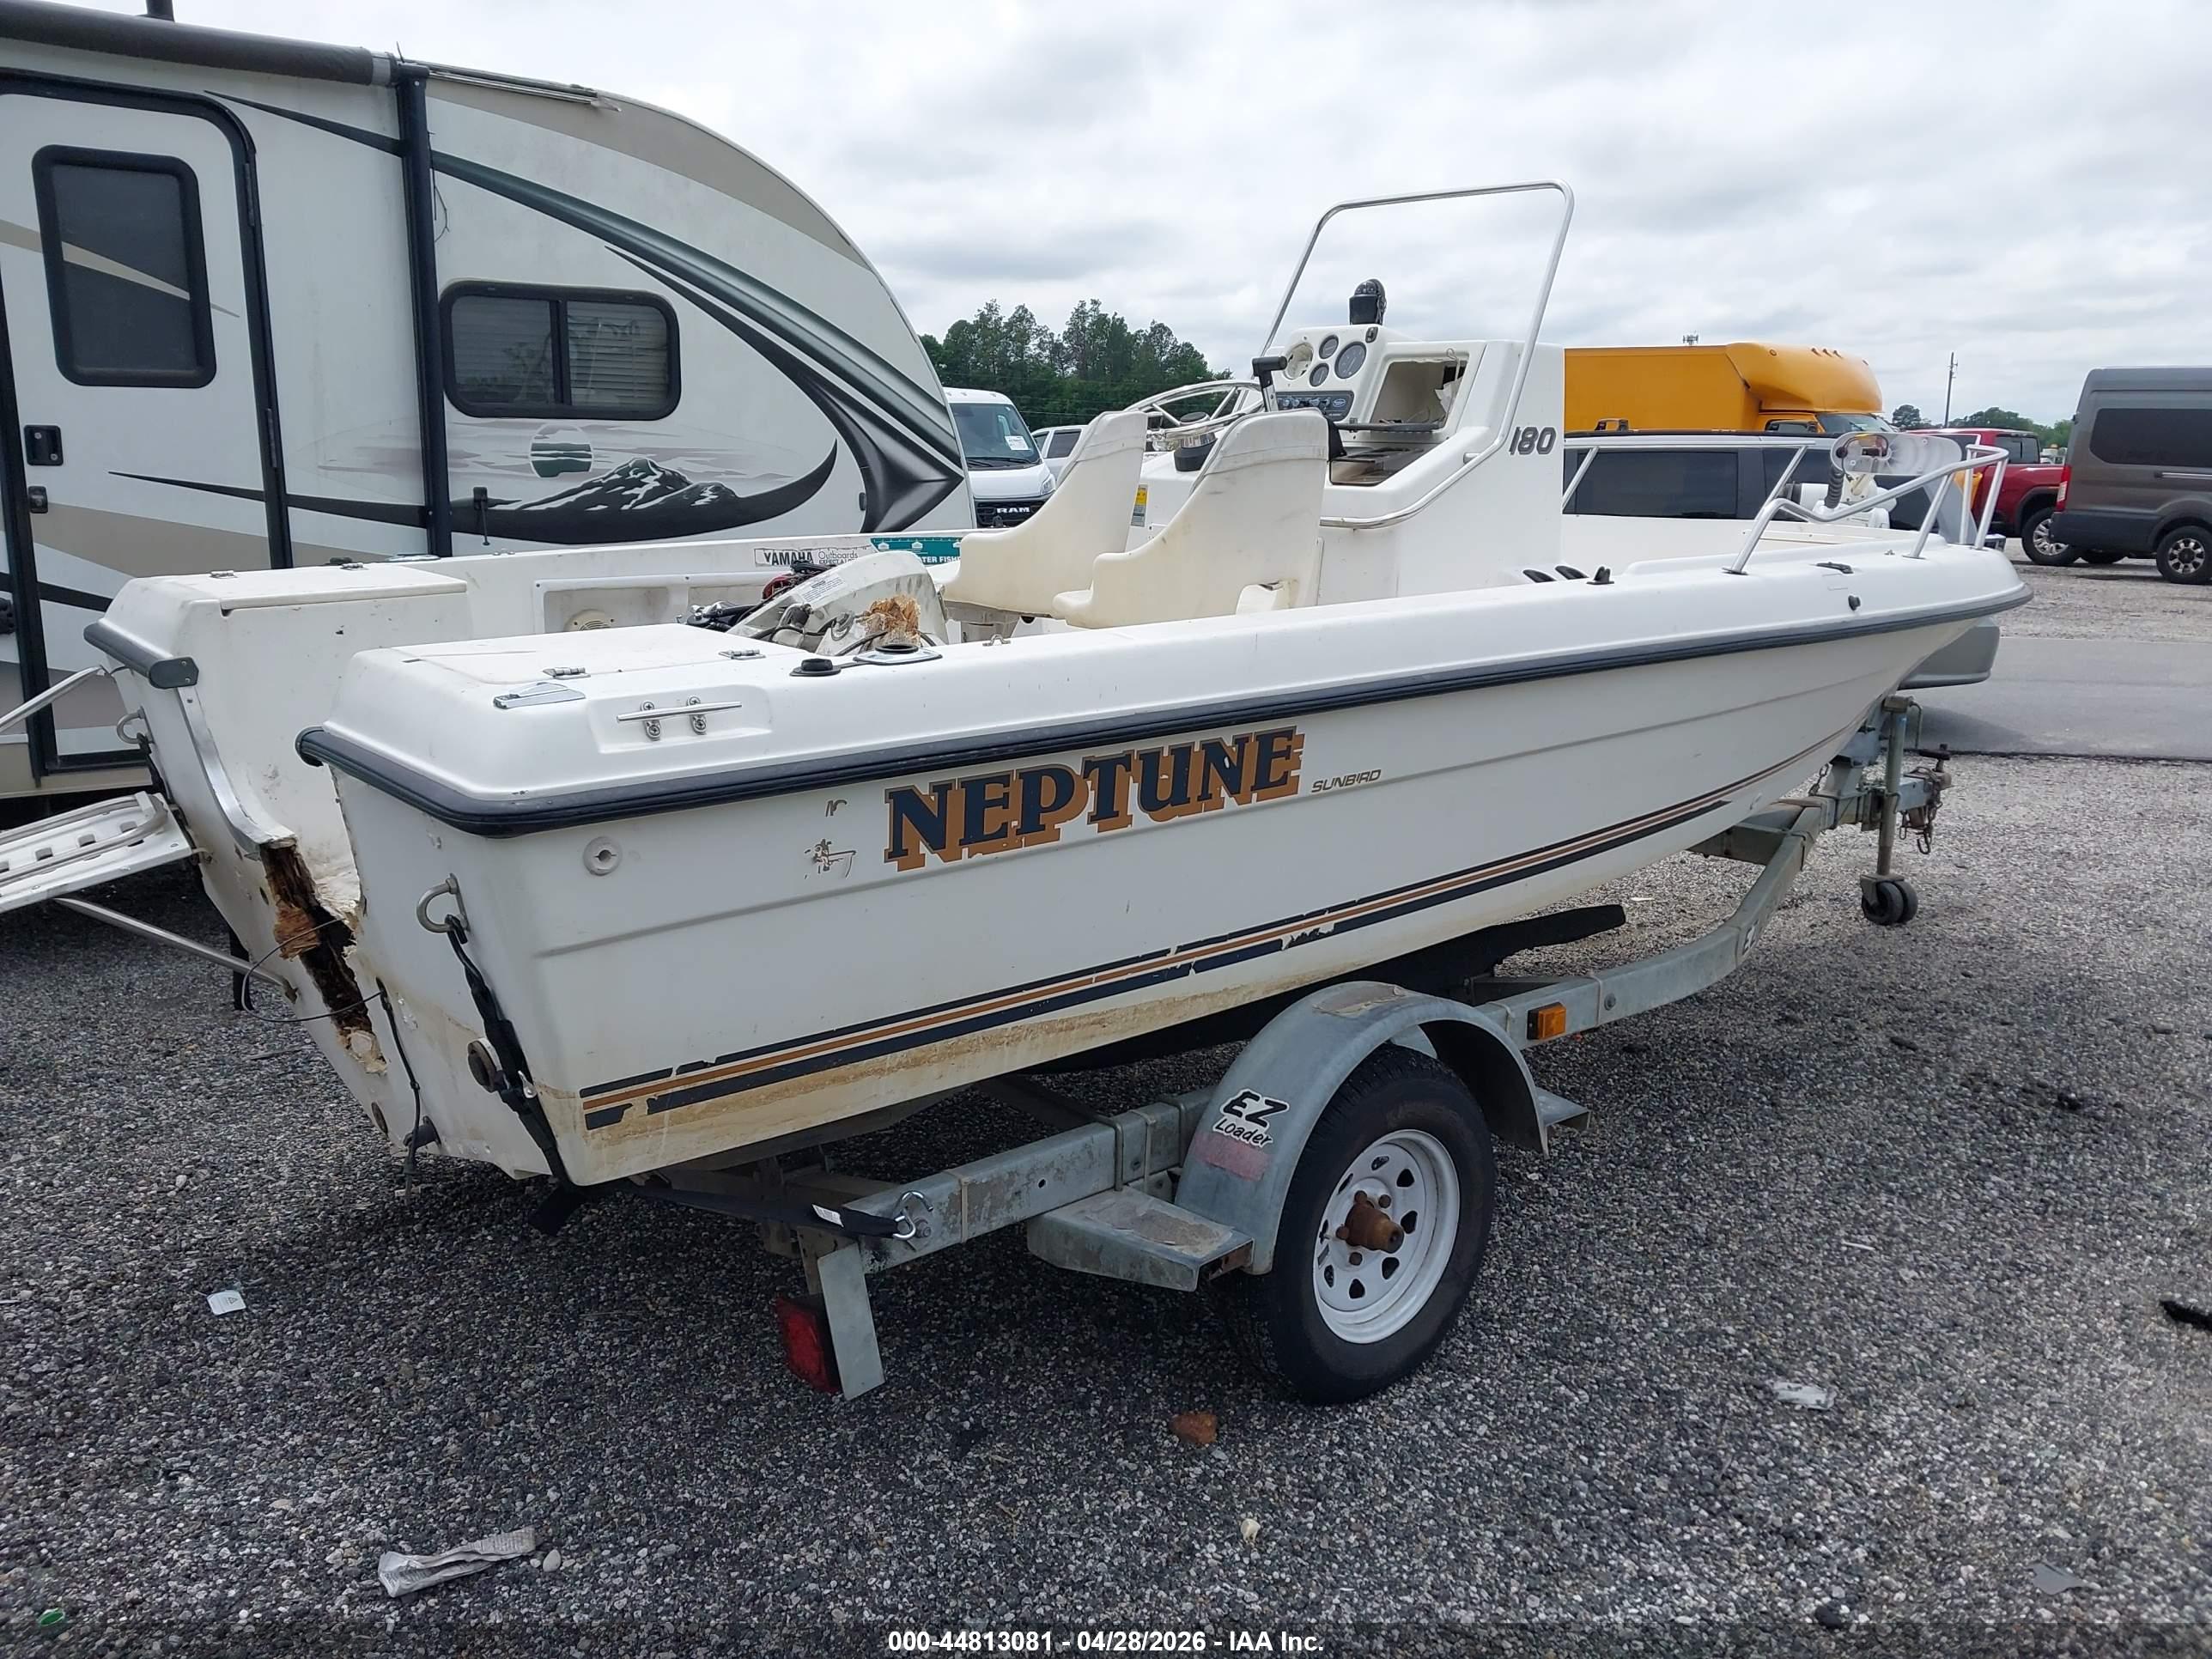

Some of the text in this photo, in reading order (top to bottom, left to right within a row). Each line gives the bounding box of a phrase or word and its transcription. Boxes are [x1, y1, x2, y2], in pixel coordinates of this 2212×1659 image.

[1509, 427, 1556, 455] 180
[763, 550, 859, 566] YAMAHA Outboards
[1311, 769, 1382, 793] SUNBIRD
[884, 726, 1305, 872] NEPTUNE
[1222, 1091, 1288, 1128] EZ
[1215, 1118, 1273, 1146] Loader
